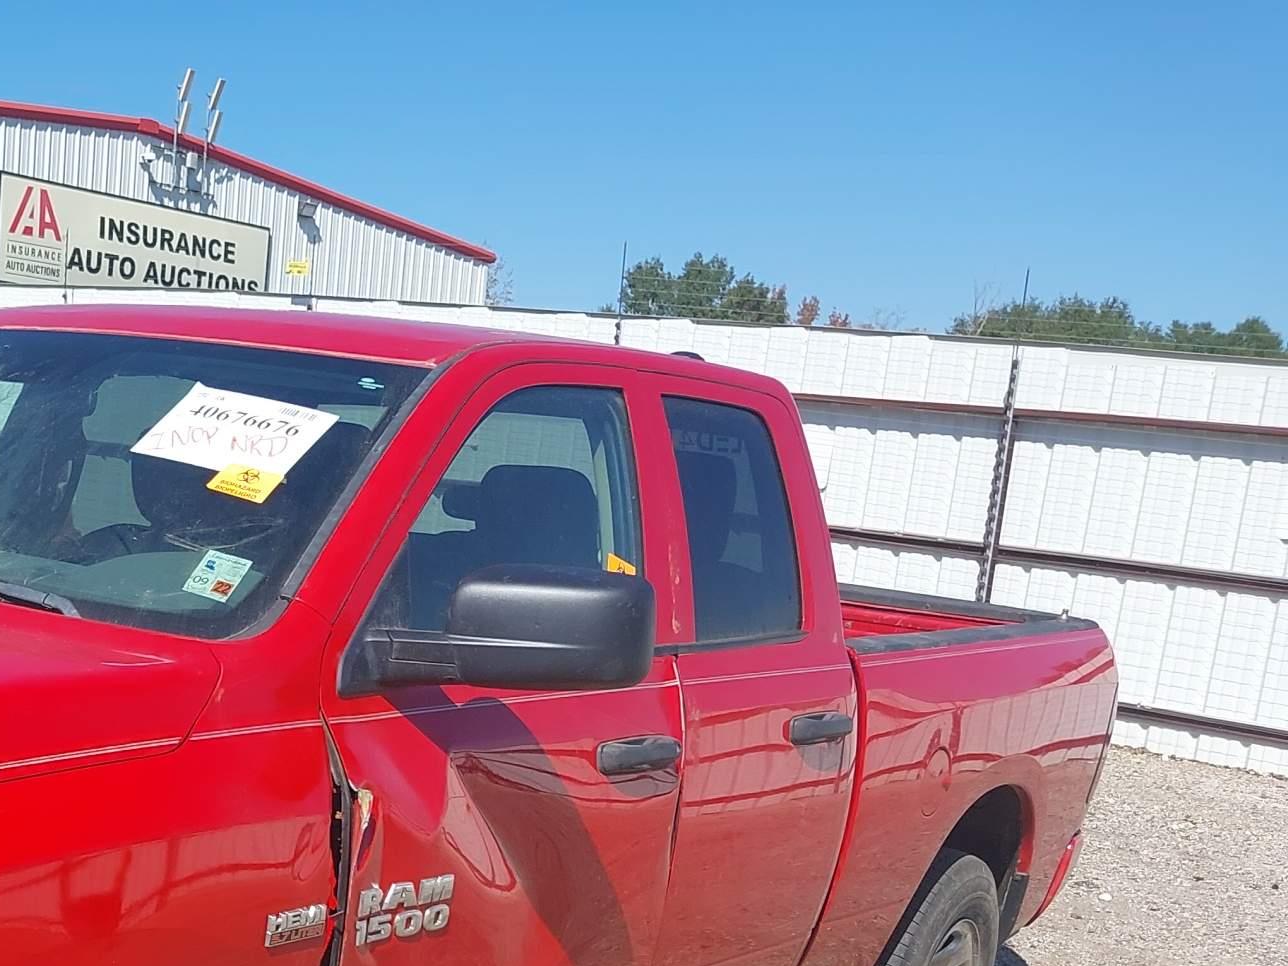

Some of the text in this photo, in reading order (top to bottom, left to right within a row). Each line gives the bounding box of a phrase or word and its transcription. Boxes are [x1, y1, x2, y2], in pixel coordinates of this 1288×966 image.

[6, 243, 62, 262] INSURANCE
[99, 216, 236, 264] INSURANCE
[5, 259, 61, 278] AUTO AUCTIONS
[67, 247, 259, 291] AUTO AUCTIONS
[189, 404, 302, 437] 40676676
[218, 479, 262, 494] BIOHAZARD
[192, 575, 209, 585] 09
[211, 580, 232, 595] 22
[357, 874, 455, 918] RAM
[267, 904, 327, 932] HEMI
[355, 904, 450, 947] 1500
